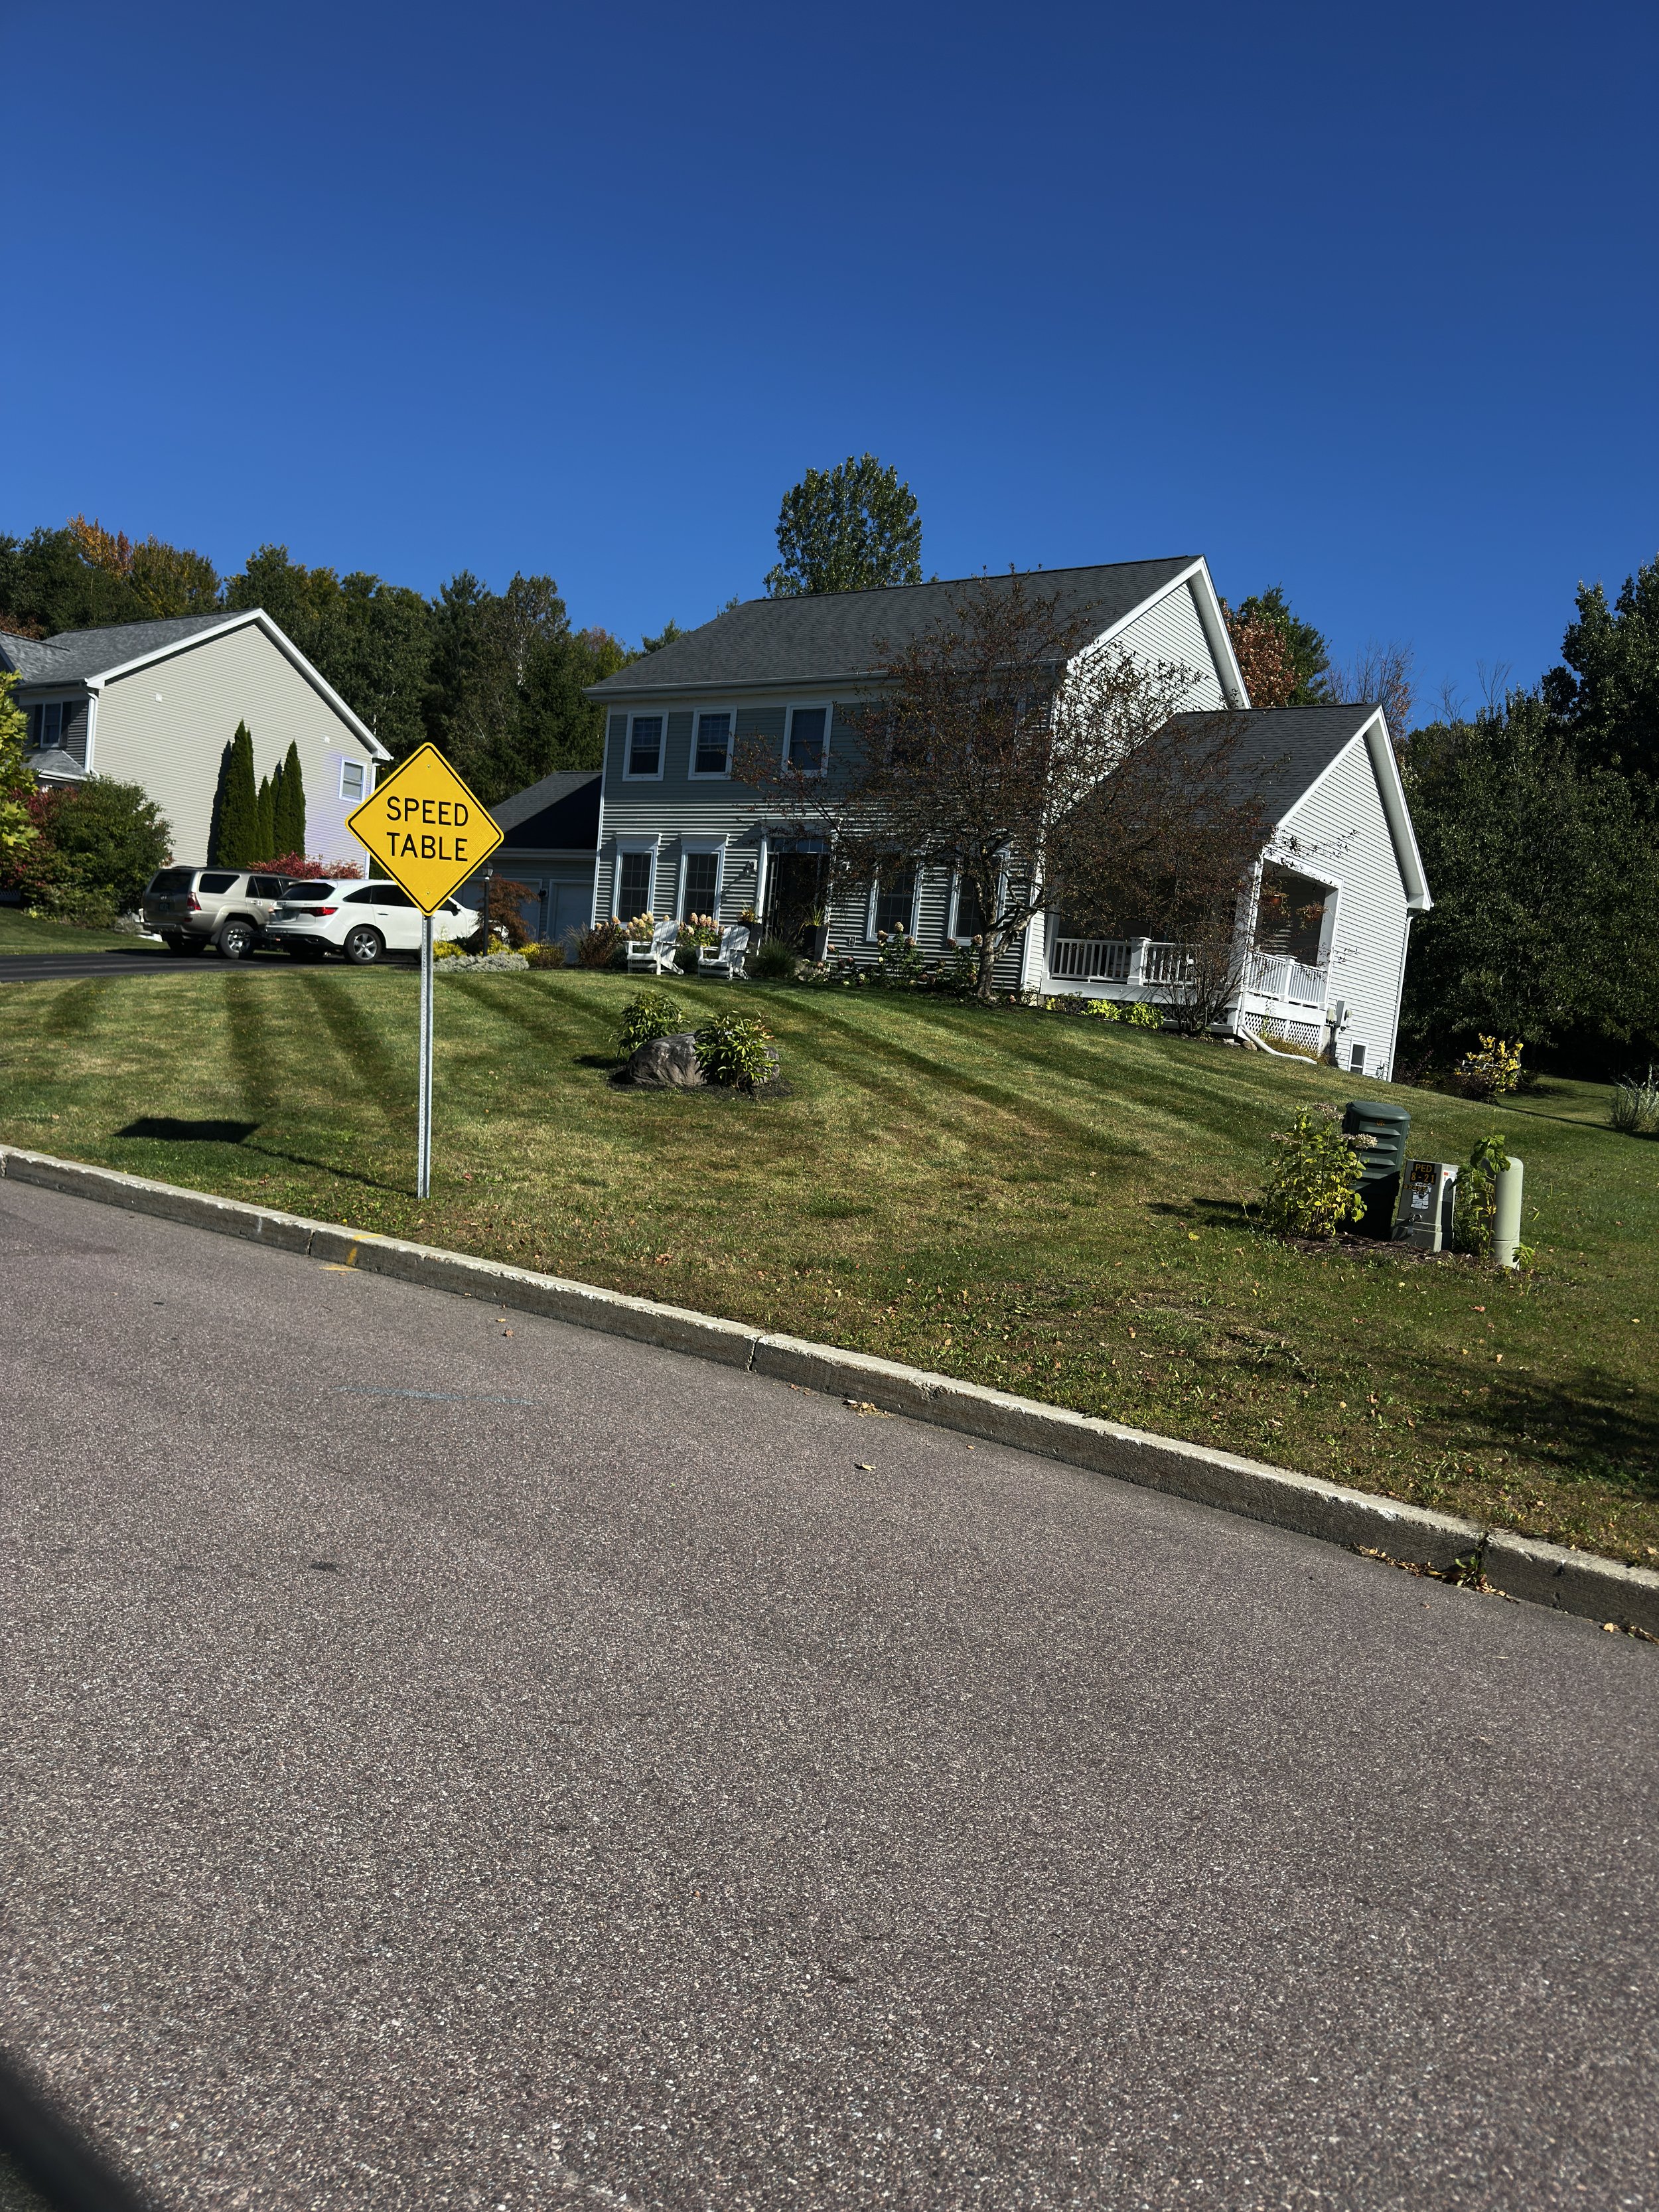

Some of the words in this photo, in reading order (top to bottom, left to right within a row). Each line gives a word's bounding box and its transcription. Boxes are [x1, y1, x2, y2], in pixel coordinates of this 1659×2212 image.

[386, 796, 469, 827] SPEED
[386, 832, 468, 861] TABLE
[1415, 1163, 1433, 1173] PED
